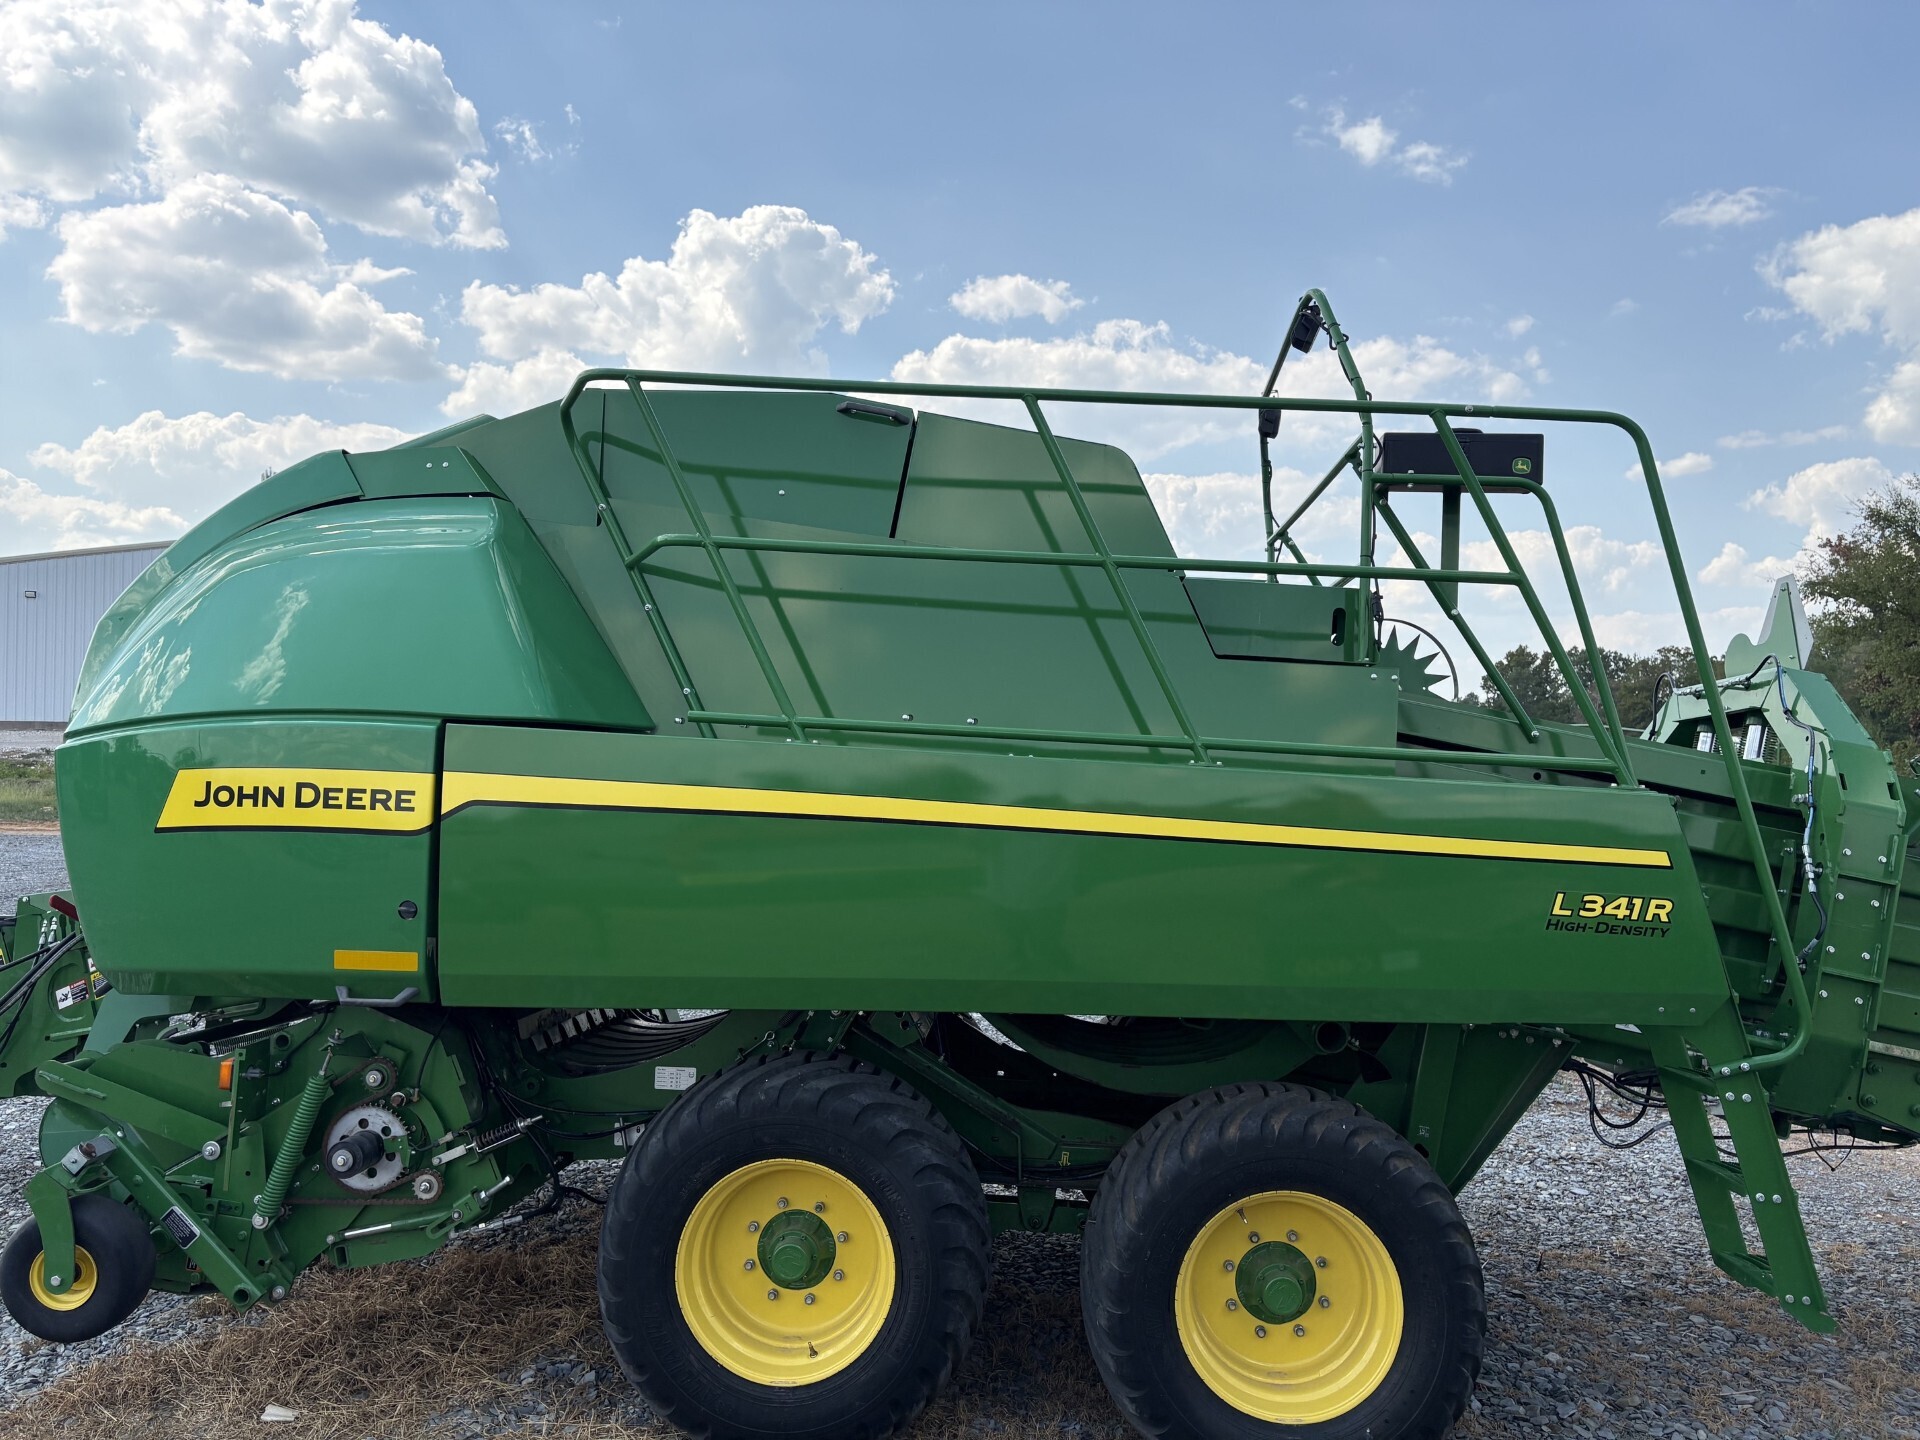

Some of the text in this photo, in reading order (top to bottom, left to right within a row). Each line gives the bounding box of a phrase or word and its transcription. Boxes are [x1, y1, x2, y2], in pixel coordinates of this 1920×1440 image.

[194, 780, 416, 812] JOHN DEERE
[1545, 918, 1671, 938] HIGH-DENSITY
